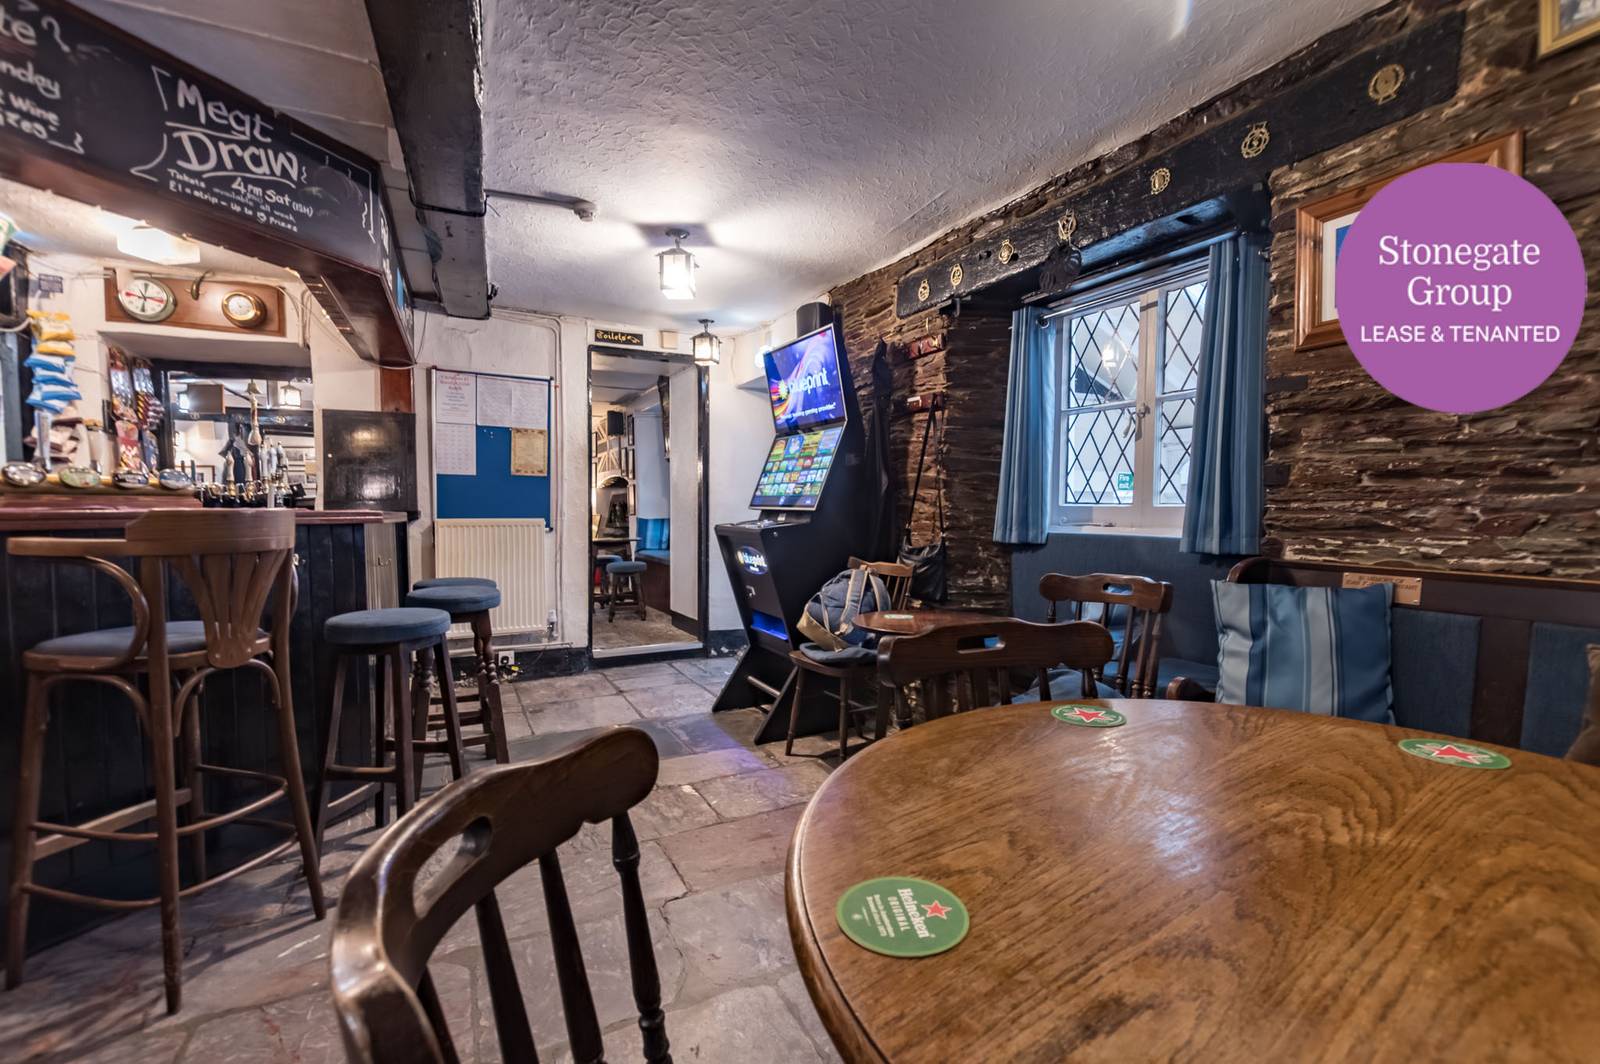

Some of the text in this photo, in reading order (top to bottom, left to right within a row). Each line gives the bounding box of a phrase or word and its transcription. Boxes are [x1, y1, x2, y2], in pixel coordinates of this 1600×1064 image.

[172, 130, 299, 182] Draw
[264, 189, 292, 206] Sat
[887, 896, 911, 932] ORIGINAL
[897, 888, 931, 938] Heineken
